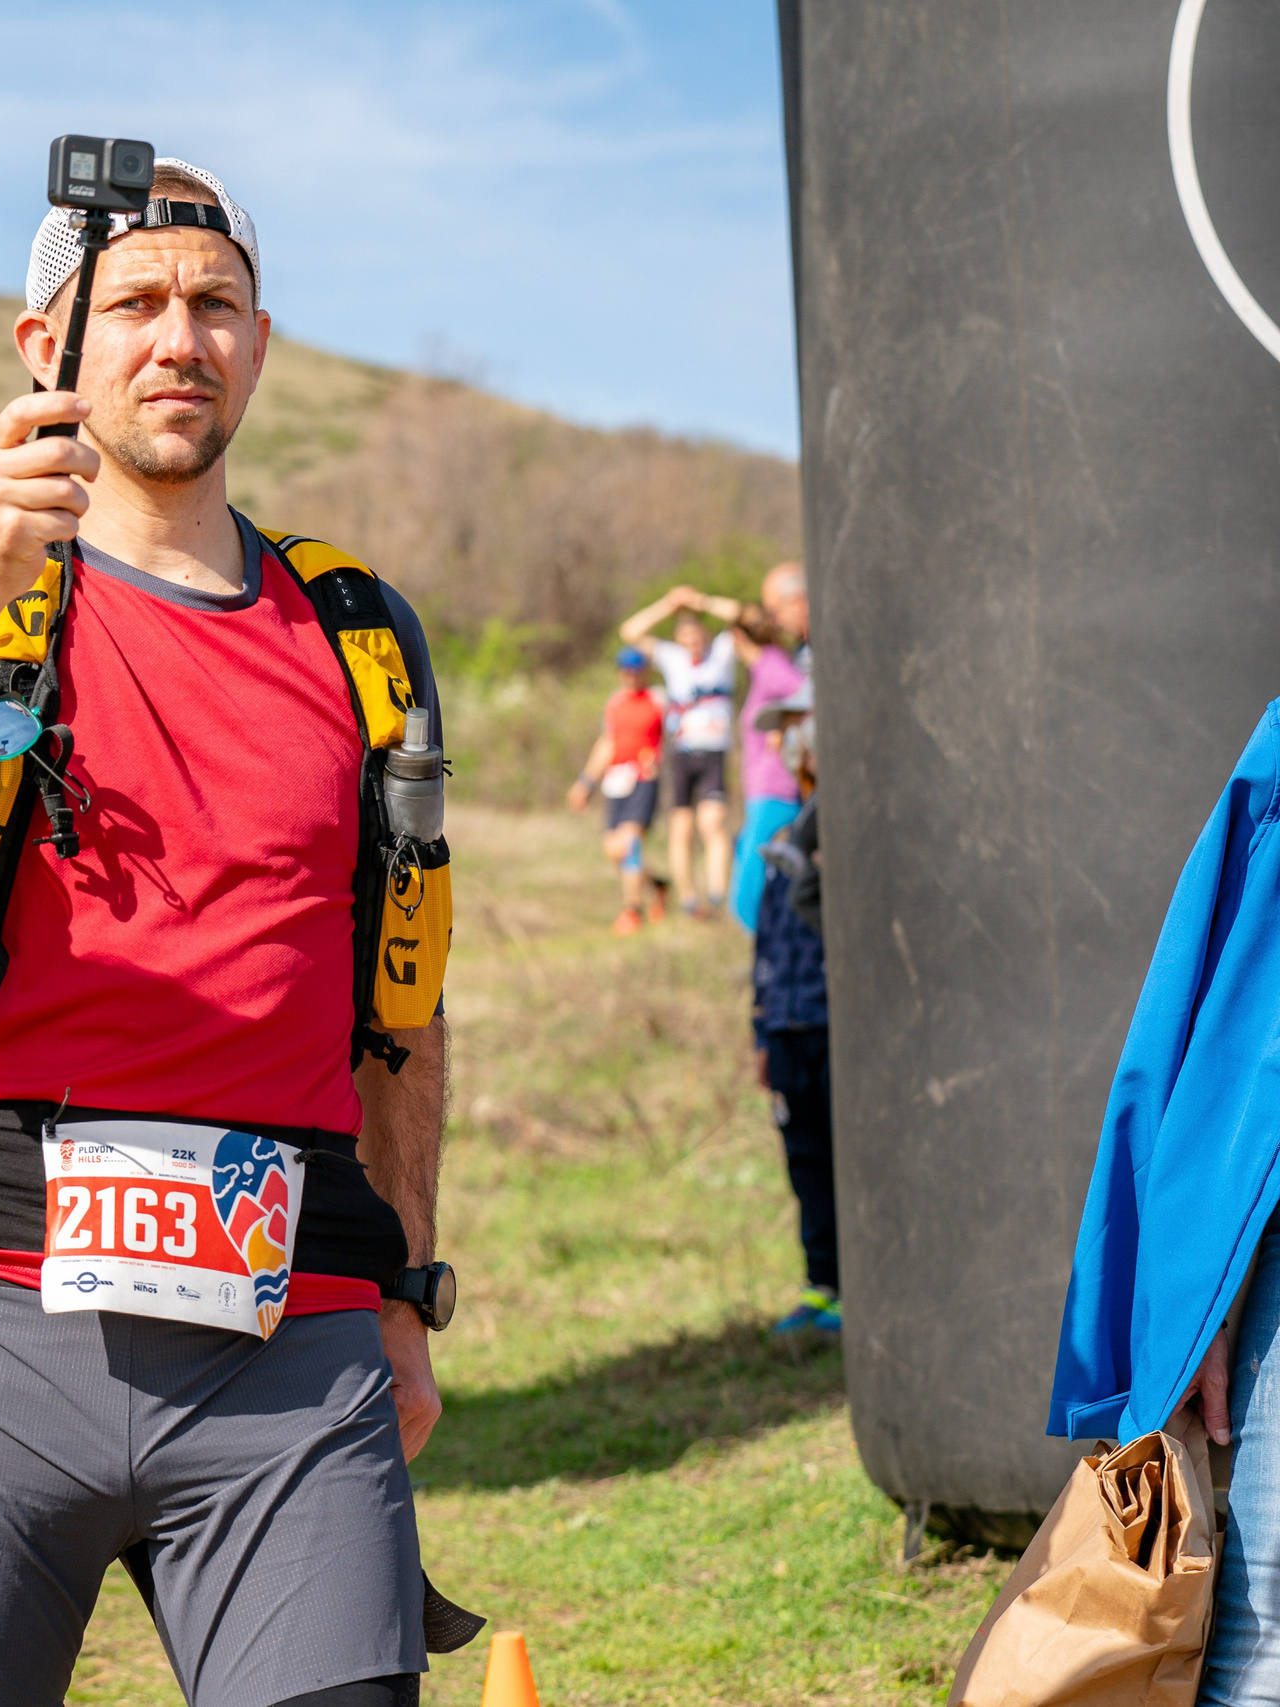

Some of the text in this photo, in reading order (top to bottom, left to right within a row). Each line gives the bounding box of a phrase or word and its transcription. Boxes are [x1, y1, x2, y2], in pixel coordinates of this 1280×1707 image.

[78, 1145, 114, 1154] PLOVDIV
[78, 1155, 102, 1163] HILLS
[171, 1149, 197, 1161] 22K
[55, 1185, 197, 1259] 2163
